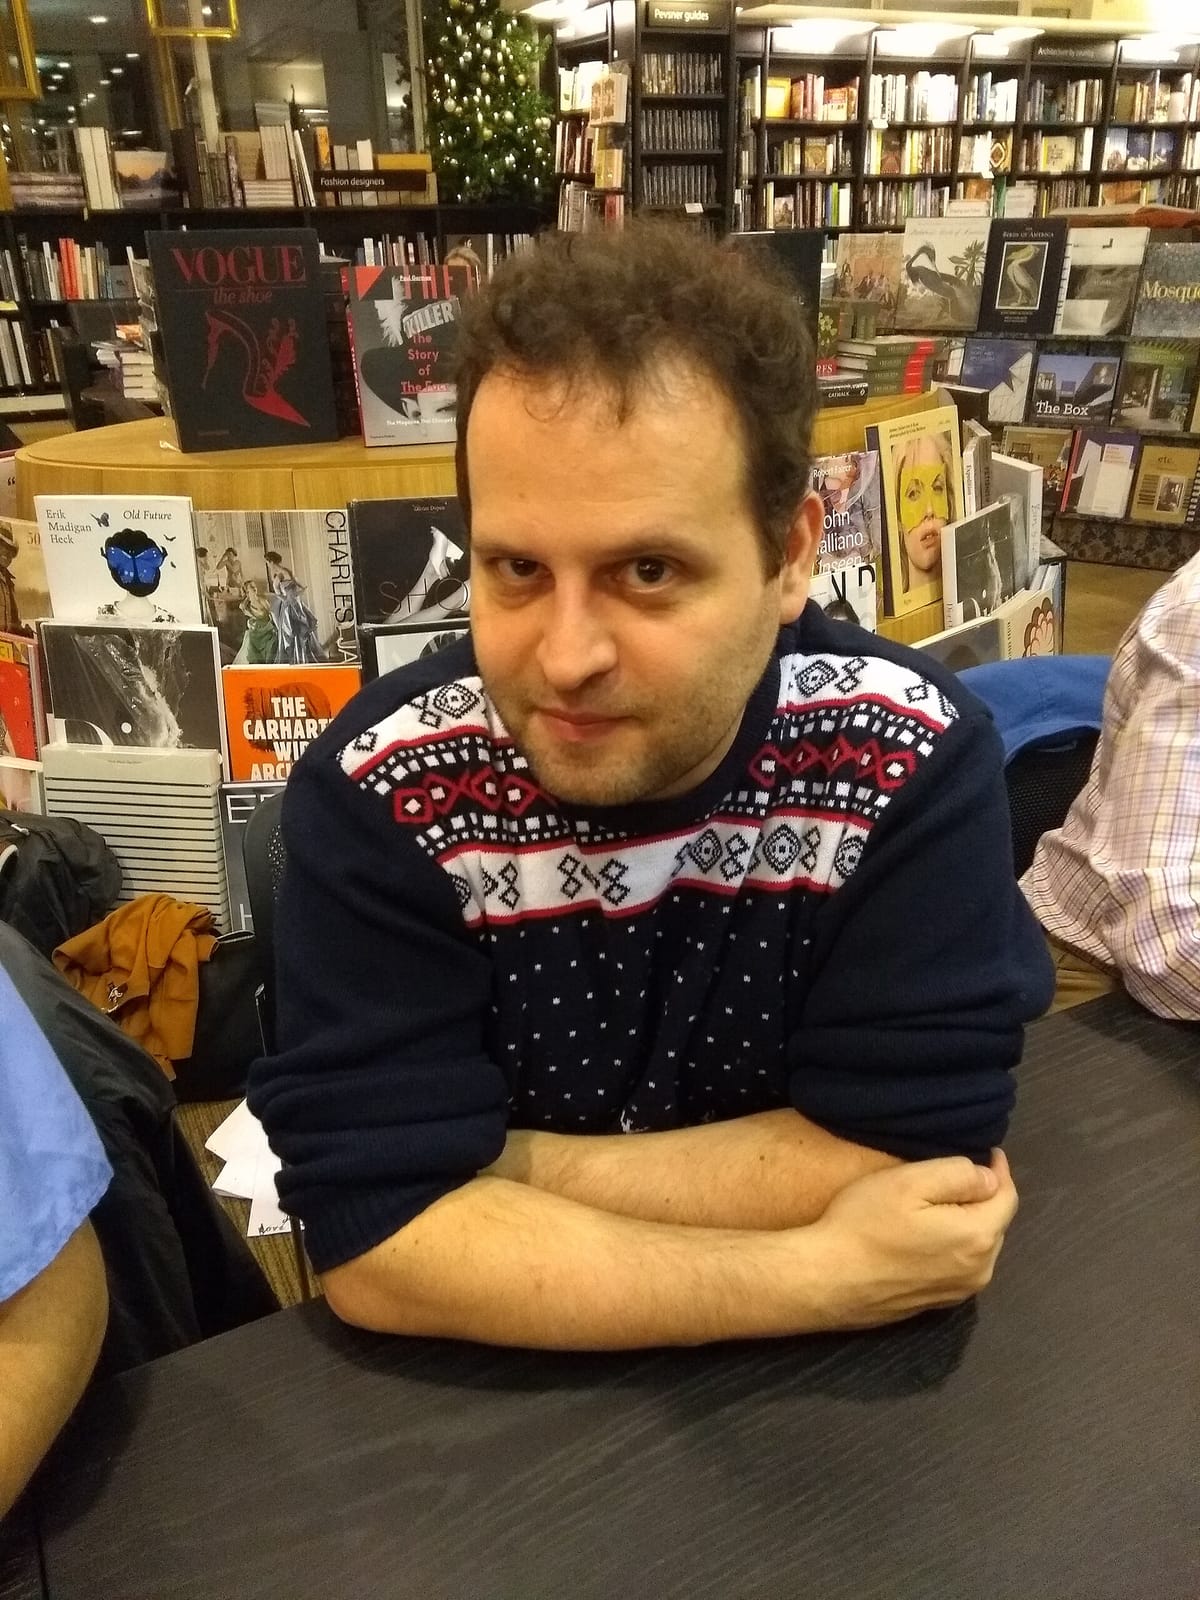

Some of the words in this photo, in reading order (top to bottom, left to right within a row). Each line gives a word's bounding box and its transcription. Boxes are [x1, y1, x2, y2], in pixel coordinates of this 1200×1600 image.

[654, 8, 683, 20] Pevsner
[684, 10, 709, 22] guides
[320, 177, 349, 186] Fashion
[350, 177, 385, 188] designers
[170, 245, 306, 285] VOGUE
[213, 286, 237, 305] the
[239, 285, 273, 304] shoe
[404, 302, 455, 339] KILLER
[408, 348, 439, 363] Story
[418, 364, 431, 376] of
[401, 381, 421, 392] The
[1035, 400, 1060, 414] The
[1062, 403, 1089, 416] Box
[46, 509, 66, 519] Erik
[123, 510, 140, 520] Old
[143, 511, 172, 521] Future
[823, 510, 850, 530] ohn
[48, 522, 92, 533] Madigan
[50, 535, 74, 544] Heck
[816, 532, 864, 555] alliano
[325, 511, 355, 623] CHARLES
[271, 696, 307, 718] THE
[243, 718, 335, 740] CARHART
[251, 762, 292, 782] ARC
